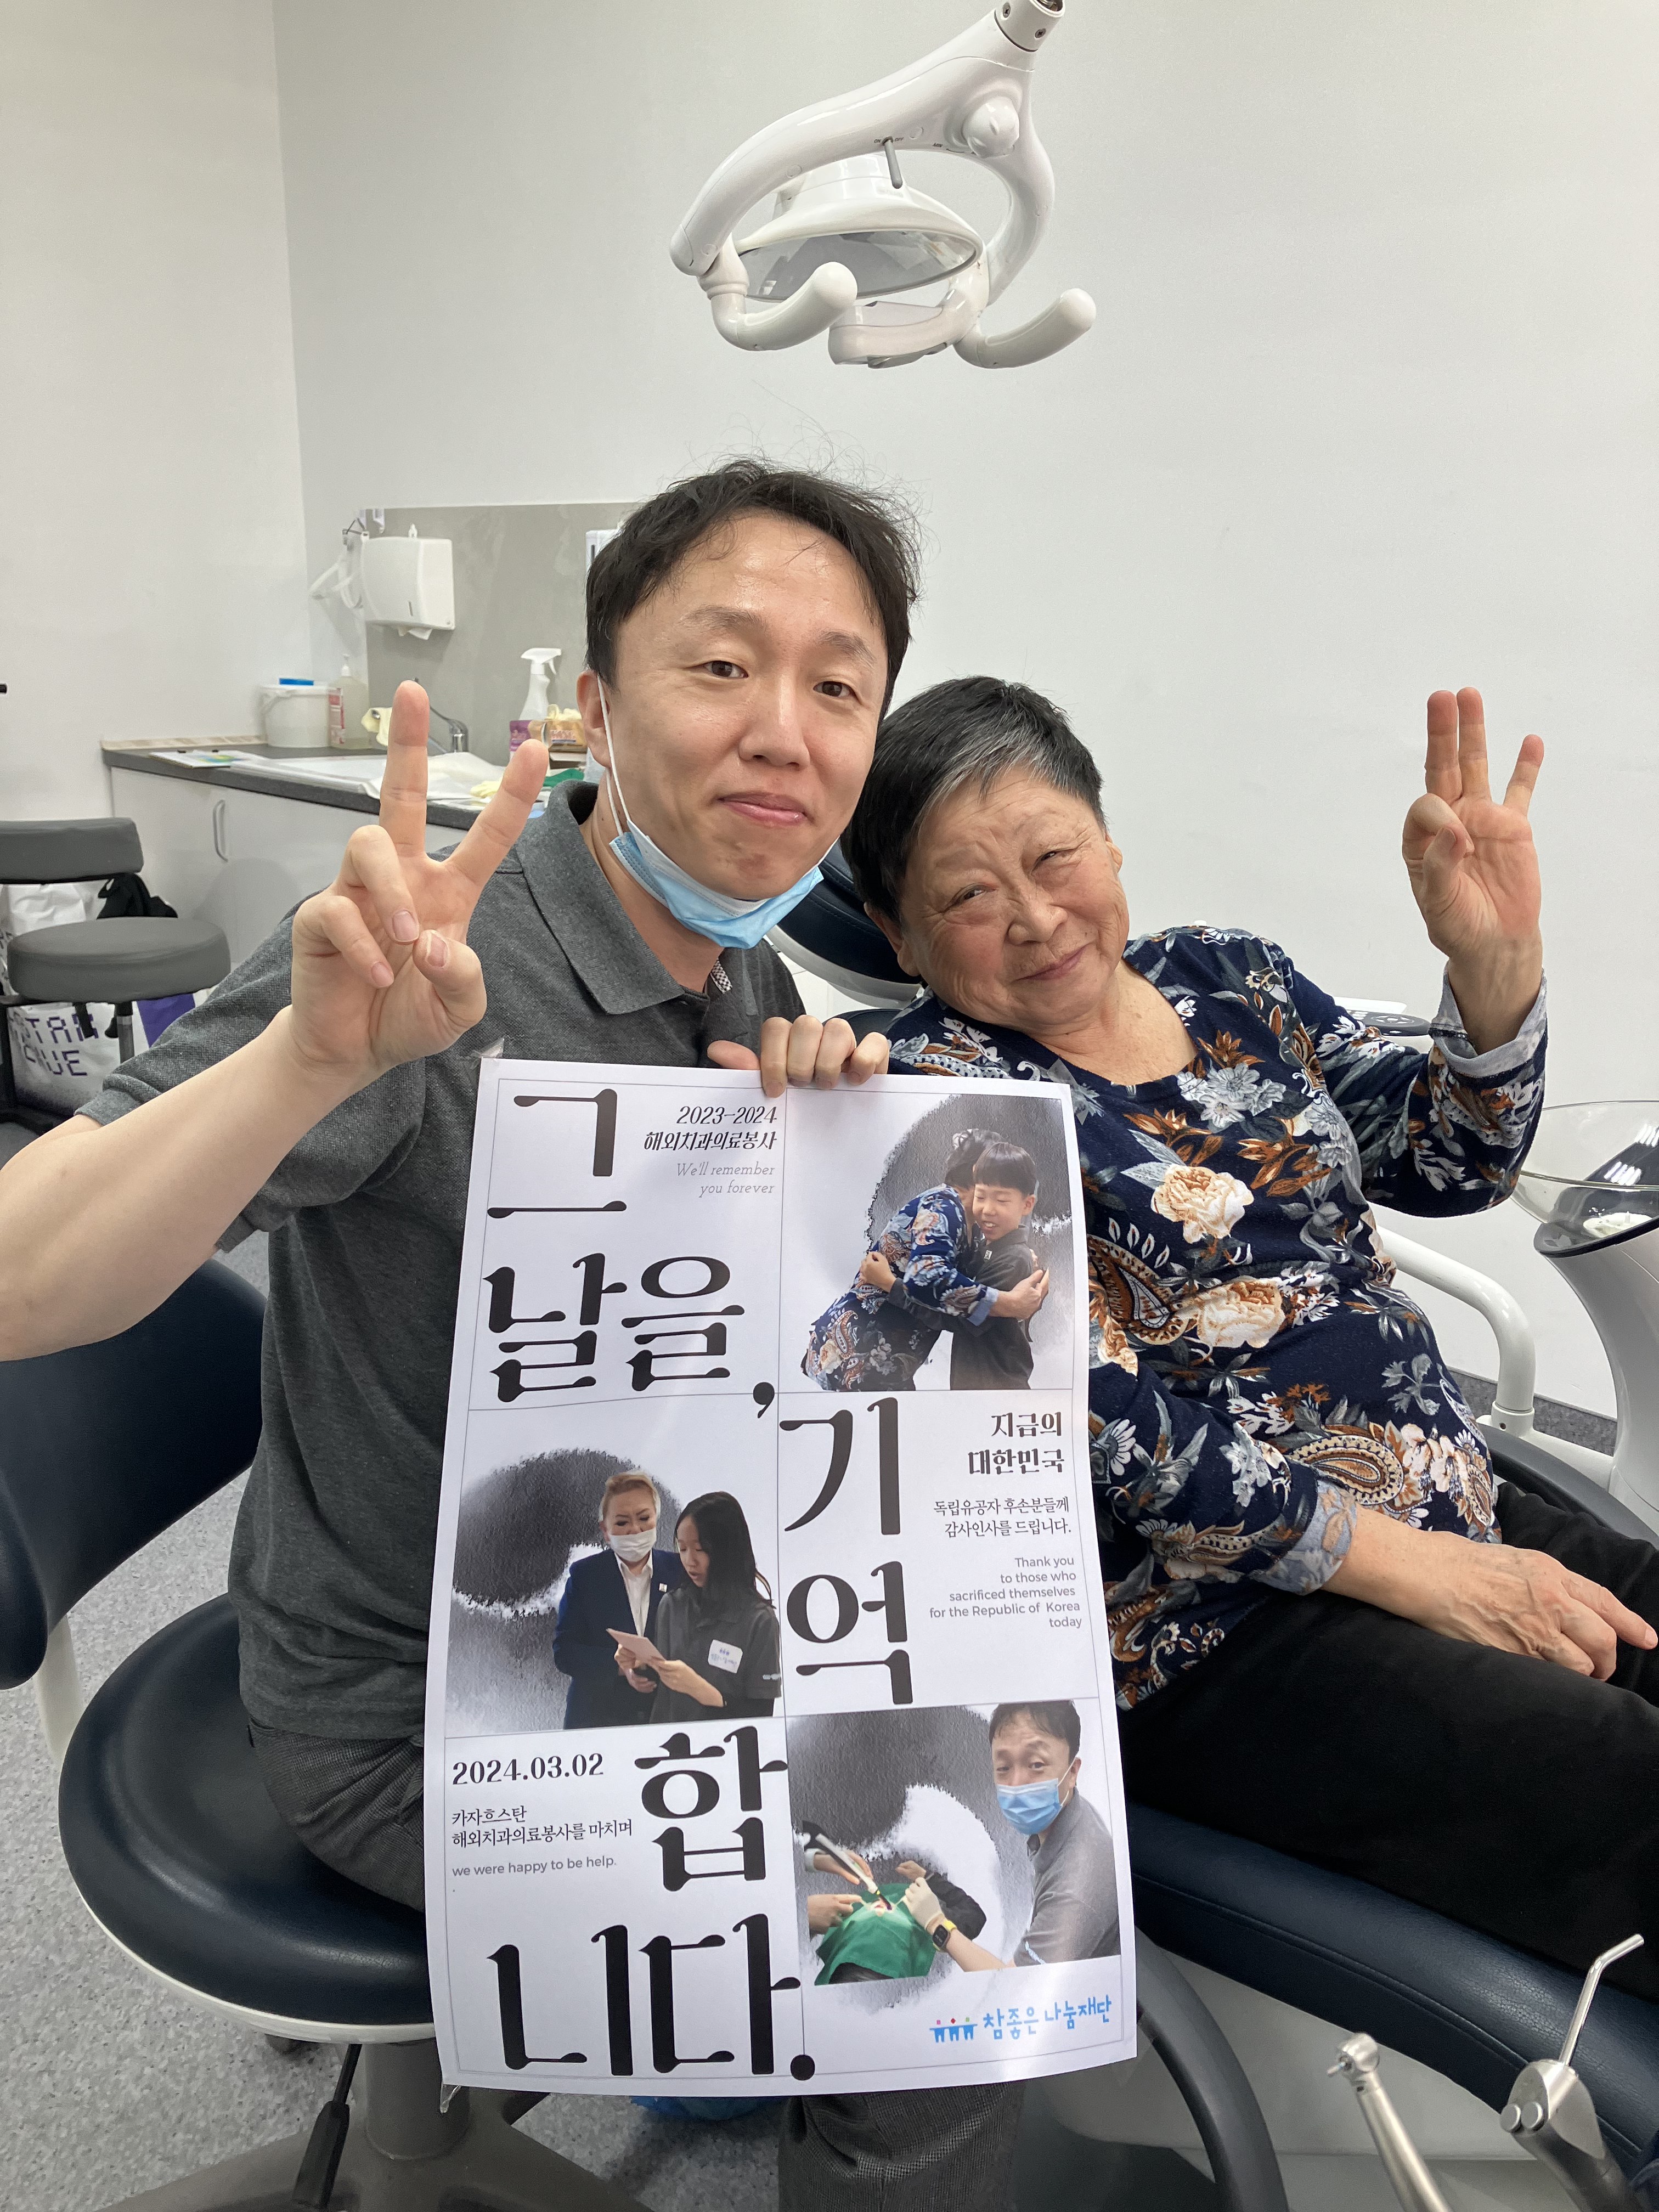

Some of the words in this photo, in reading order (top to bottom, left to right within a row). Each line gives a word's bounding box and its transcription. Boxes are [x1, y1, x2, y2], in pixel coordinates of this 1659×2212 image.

[676, 1105, 777, 1125] 2023-2024
[644, 1131, 777, 1151] 해외치과의료봉사
[487, 1088, 627, 1218] 그
[677, 1161, 709, 1176] We'll
[710, 1161, 775, 1175] remember
[698, 1184, 723, 1198] you
[726, 1179, 775, 1194] forever
[991, 1411, 1062, 1437] 지금의
[967, 1448, 1065, 1475] 대한민국
[933, 1498, 1001, 1517] 독립유공자
[1003, 1496, 1069, 1515] 후손분들께
[944, 1520, 1012, 1538] 감사인사를
[1014, 1517, 1071, 1535] 드립니다.
[1014, 1556, 1051, 1568] Thank
[1053, 1557, 1075, 1568] you
[1000, 1573, 1013, 1584] to
[1015, 1572, 1048, 1583] those
[1050, 1570, 1077, 1582] who
[949, 1588, 1006, 1601] sacrificed
[1009, 1586, 1076, 1599] themselves
[929, 1607, 946, 1618] for
[949, 1606, 969, 1617] the
[972, 1603, 1026, 1618] Republic
[1028, 1602, 1041, 1613] of
[1046, 1601, 1081, 1613] Korea
[1048, 1616, 1082, 1629] today
[452, 1752, 604, 1785] 2024.03.02
[452, 1805, 527, 1827] 카자흐스탄
[452, 1822, 586, 1848] 해외치과의료봉사를
[588, 1818, 633, 1838] 마치며
[452, 1866, 471, 1876] we
[473, 1864, 505, 1875] were
[508, 1861, 548, 1875] happy
[550, 1859, 563, 1870] to
[567, 1858, 583, 1869] be
[586, 1855, 617, 1869] help.
[983, 2006, 1039, 2040] 참좋은
[1044, 1994, 1112, 2030] 나눔재단
